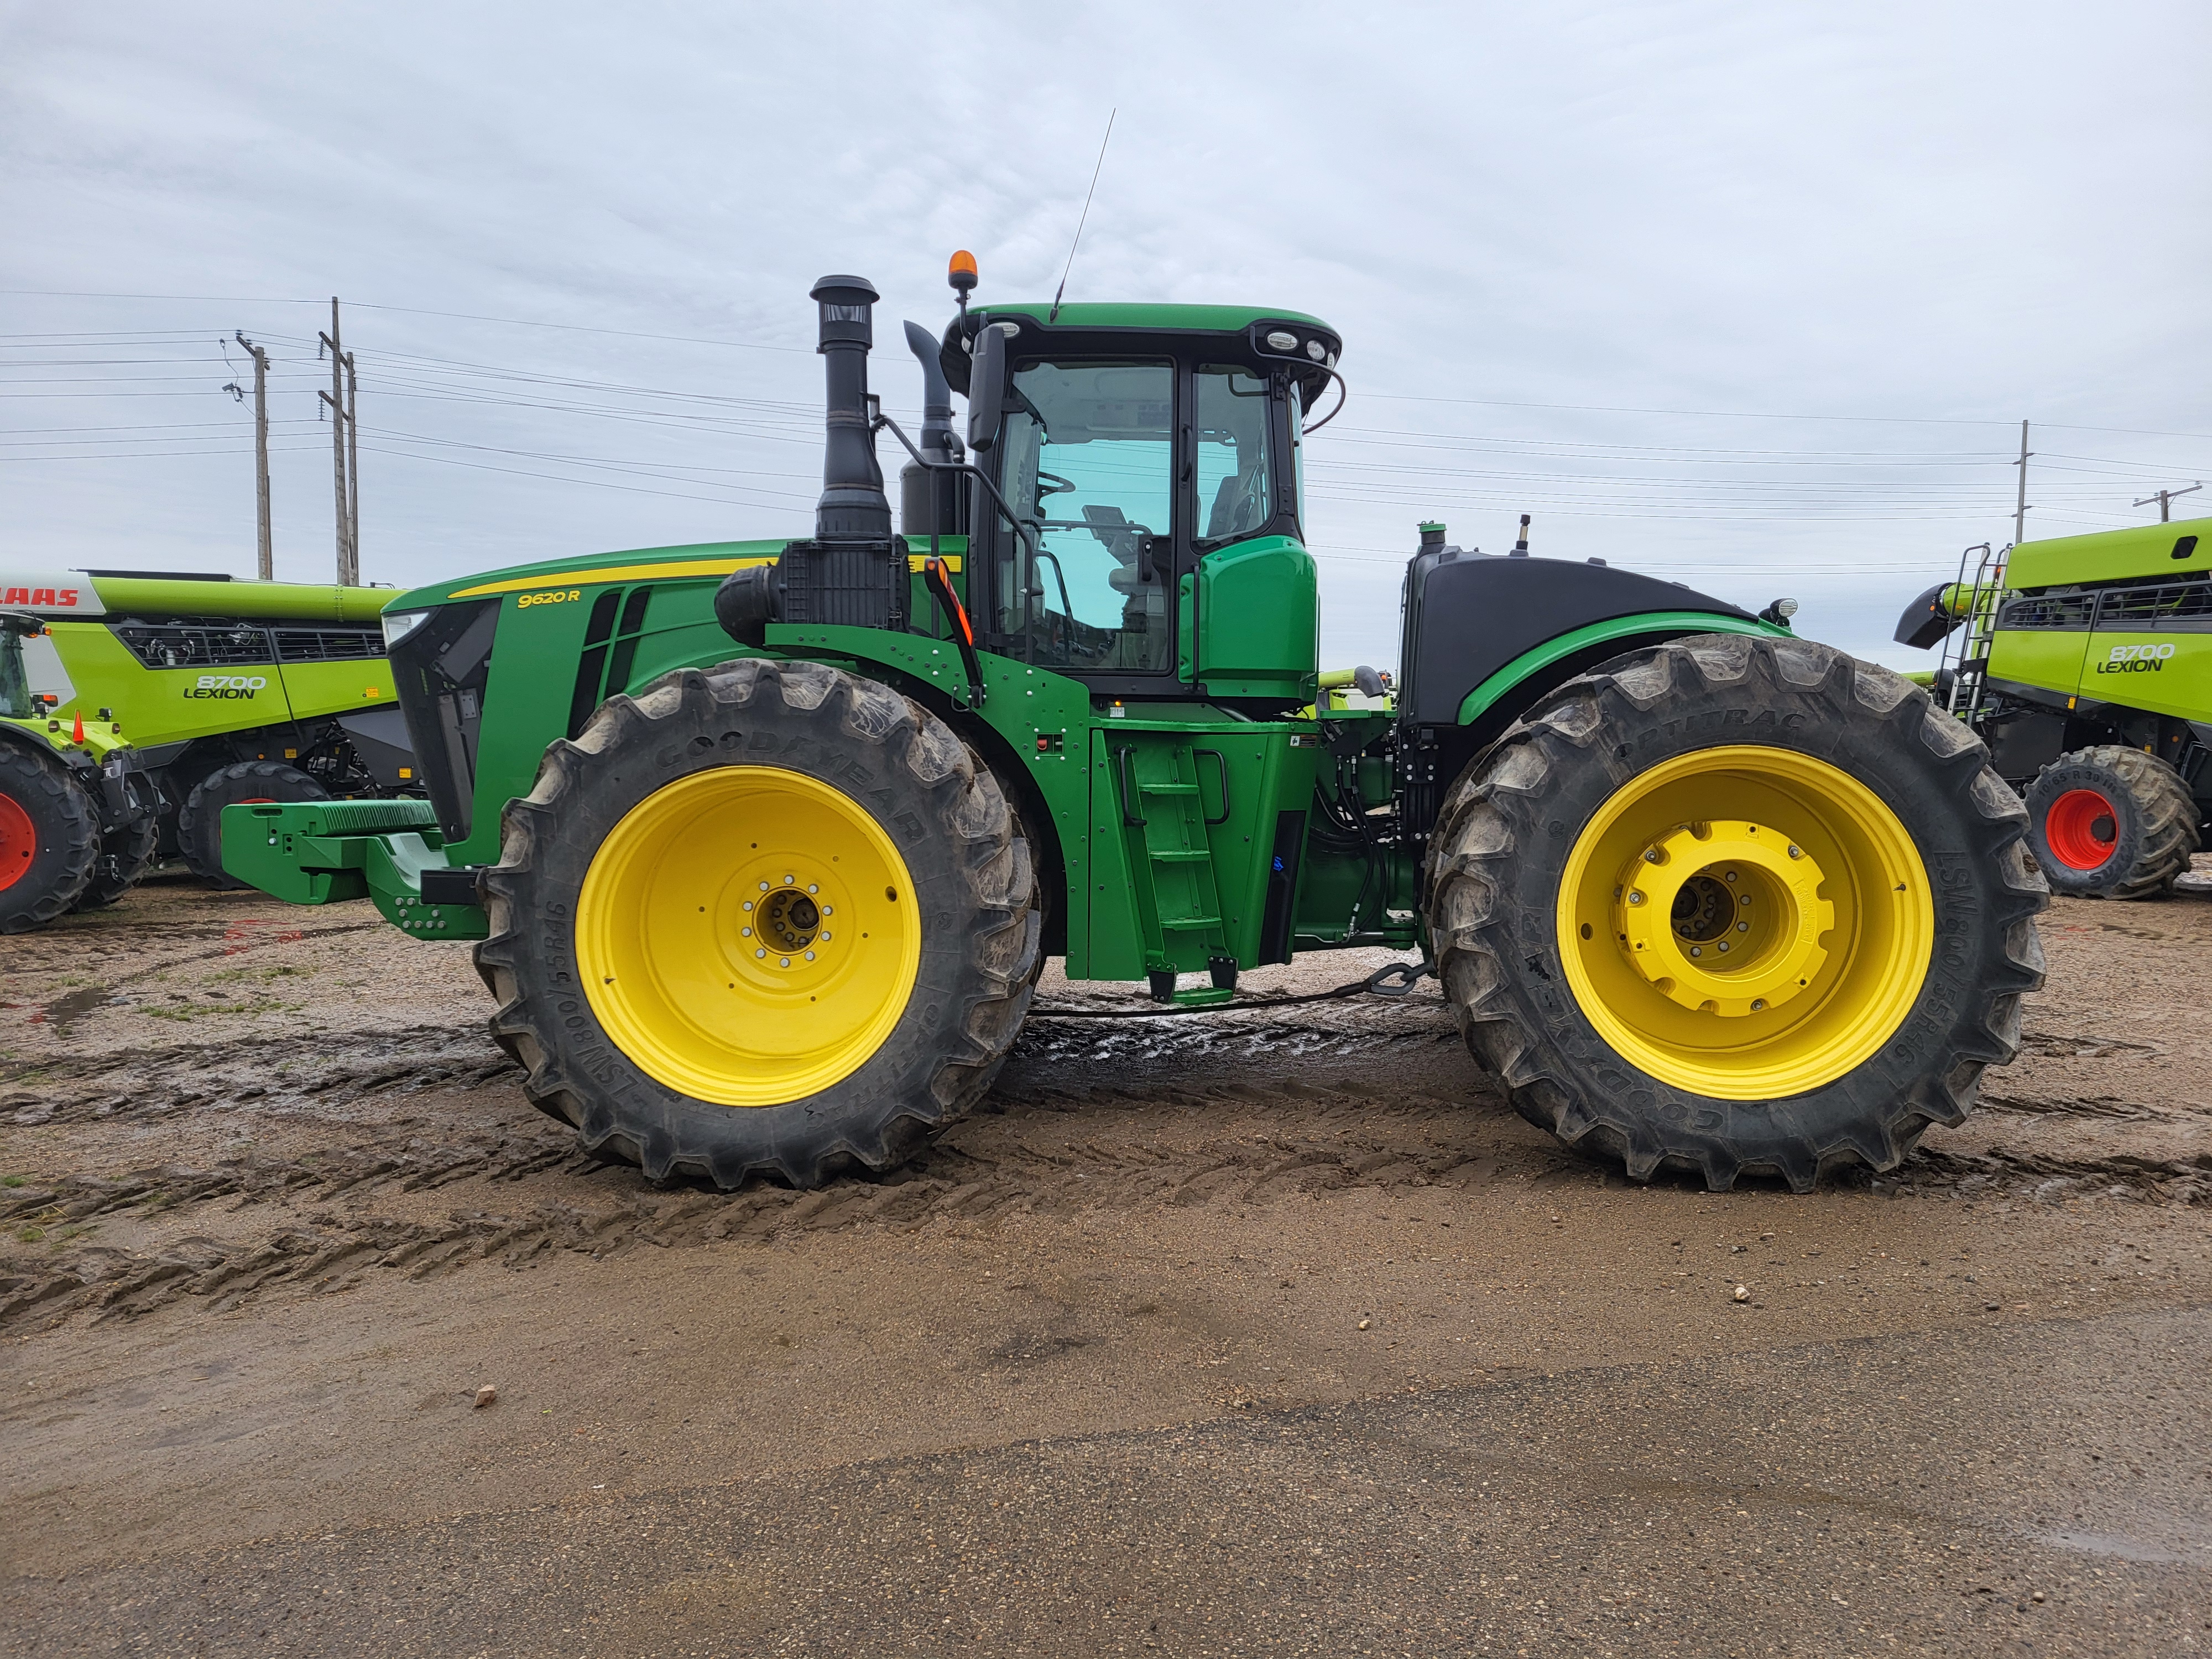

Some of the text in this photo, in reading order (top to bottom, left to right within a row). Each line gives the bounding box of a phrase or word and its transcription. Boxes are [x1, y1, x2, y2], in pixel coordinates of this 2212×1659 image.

[0, 587, 79, 606] AAS
[518, 590, 581, 608] 9620 R
[2109, 643, 2176, 662] 8700
[2096, 658, 2163, 674] LEXION
[196, 676, 267, 690] 8700
[183, 688, 255, 700] LEXION
[1613, 708, 1806, 763] OPTITRAC
[655, 731, 930, 845] GOODYEAR
